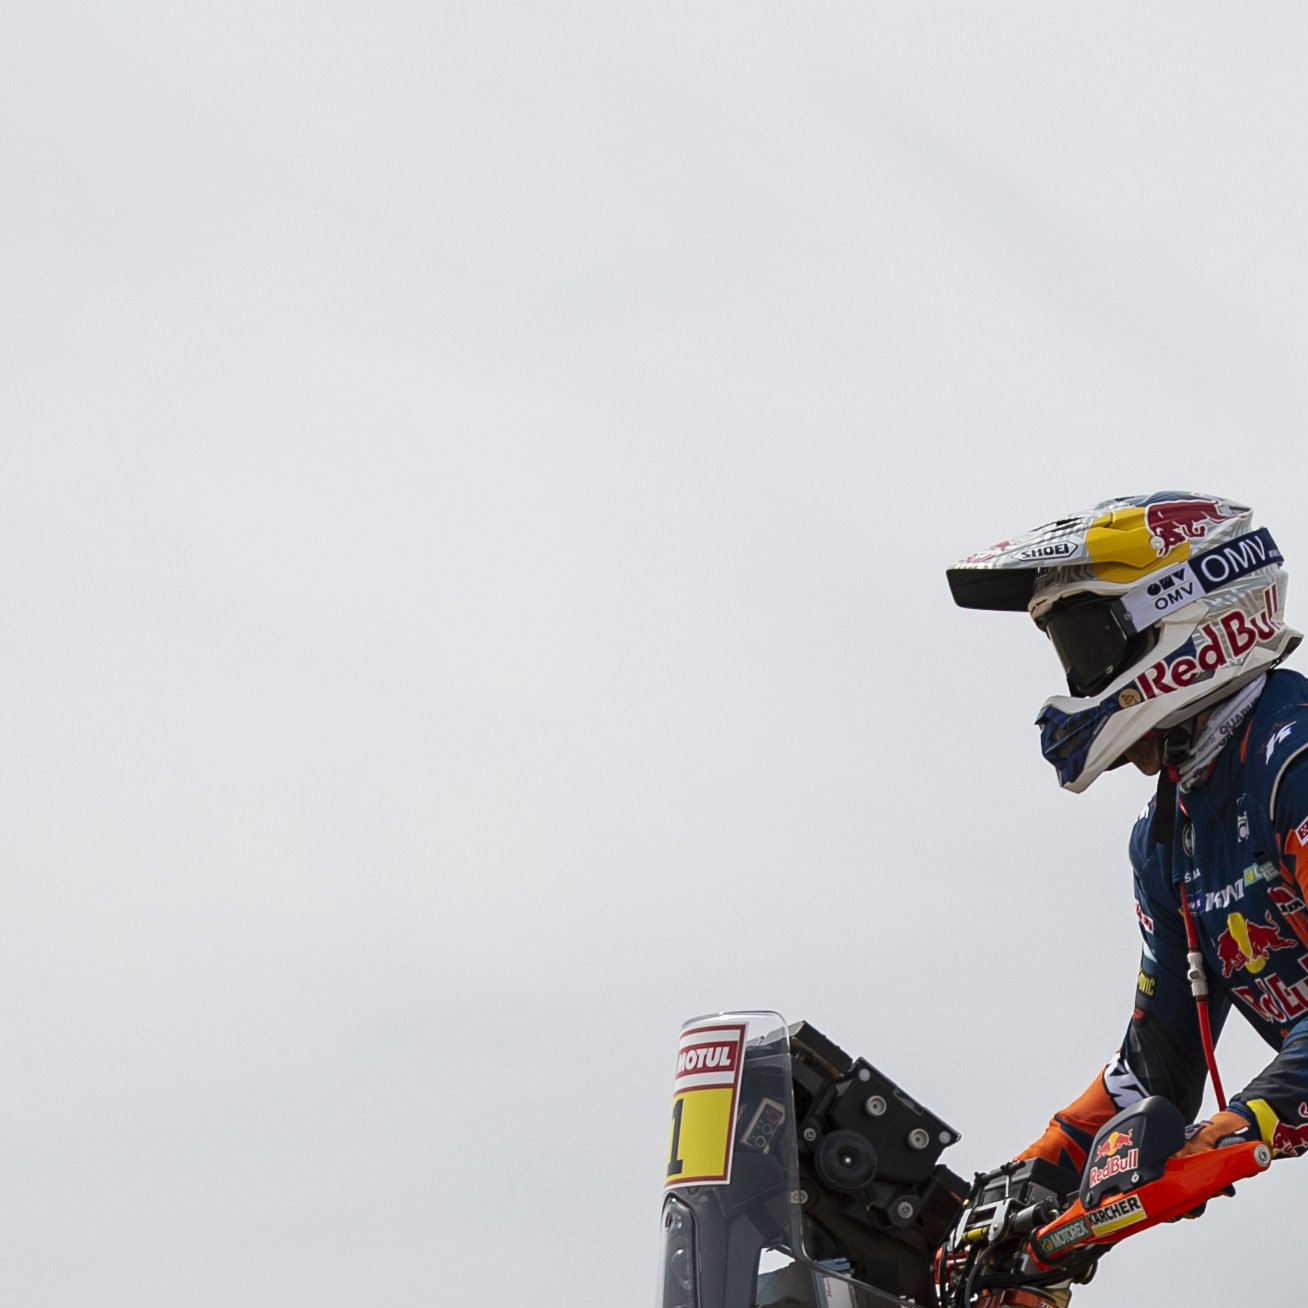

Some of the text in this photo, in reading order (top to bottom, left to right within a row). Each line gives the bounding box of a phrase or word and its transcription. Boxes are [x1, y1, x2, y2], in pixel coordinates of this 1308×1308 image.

[1021, 543, 1069, 558] SHOEI
[1201, 535, 1266, 582] OMV
[1155, 582, 1193, 610] OMV
[1136, 584, 1281, 700] Red Bull
[677, 1046, 731, 1072] MOTUL
[666, 1098, 684, 1176] 1
[1089, 1149, 1139, 1188] Red Bull
[1050, 1221, 1089, 1248] MOTOREX
